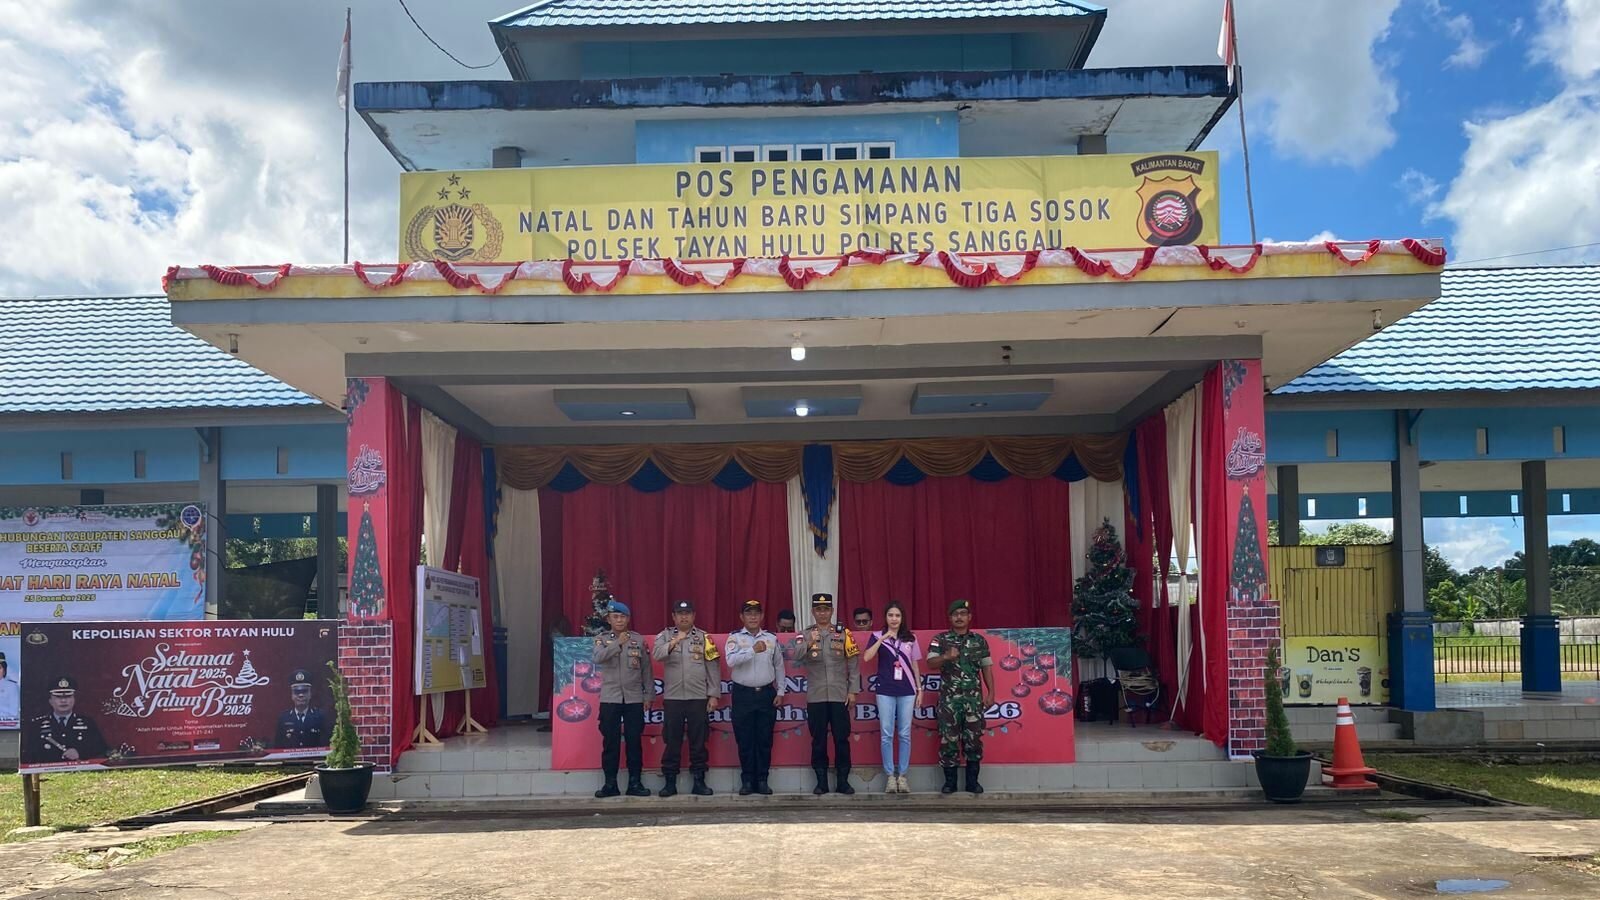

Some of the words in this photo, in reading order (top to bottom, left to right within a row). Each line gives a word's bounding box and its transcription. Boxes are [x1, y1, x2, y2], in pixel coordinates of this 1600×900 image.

[1135, 159, 1177, 172] KALIMANTAN
[1178, 160, 1201, 170] BARAT
[676, 169, 734, 198] POS
[751, 165, 962, 196] PENGAMANAN
[520, 208, 593, 233] NATAL
[608, 207, 654, 231] DAN
[668, 206, 747, 229] TAHUN
[762, 203, 825, 227] BARU
[840, 201, 948, 225] SIMPANG
[961, 200, 1017, 223] TIGA
[1030, 198, 1111, 222] SOSOK
[568, 237, 660, 260] POLSEK
[674, 235, 747, 258] TAYAN
[762, 233, 825, 256] HULU
[949, 228, 1063, 253] SANGGAU
[65, 531, 127, 541] KABUPATEN
[130, 529, 181, 539] SANGGAU
[26, 544, 69, 553] BESERTA
[71, 543, 102, 552] STAFF
[20, 558, 107, 569] Mengucapkan
[27, 575, 72, 590] HARI
[75, 573, 123, 589] RAYA
[127, 572, 181, 588] NATAL
[36, 594, 75, 602] Desember
[53, 604, 64, 617] &
[72, 628, 156, 640] KEPOLISIAN
[159, 627, 211, 638] SEKTOR
[214, 627, 258, 638] TAYAN
[261, 627, 295, 637] HULU
[140, 642, 235, 673] Selamat
[113, 664, 199, 698] Natal
[198, 668, 227, 679] 2025
[131, 696, 145, 708] &
[137, 689, 202, 718] Tahun
[191, 686, 254, 718] Baru
[223, 705, 252, 716] 2026
